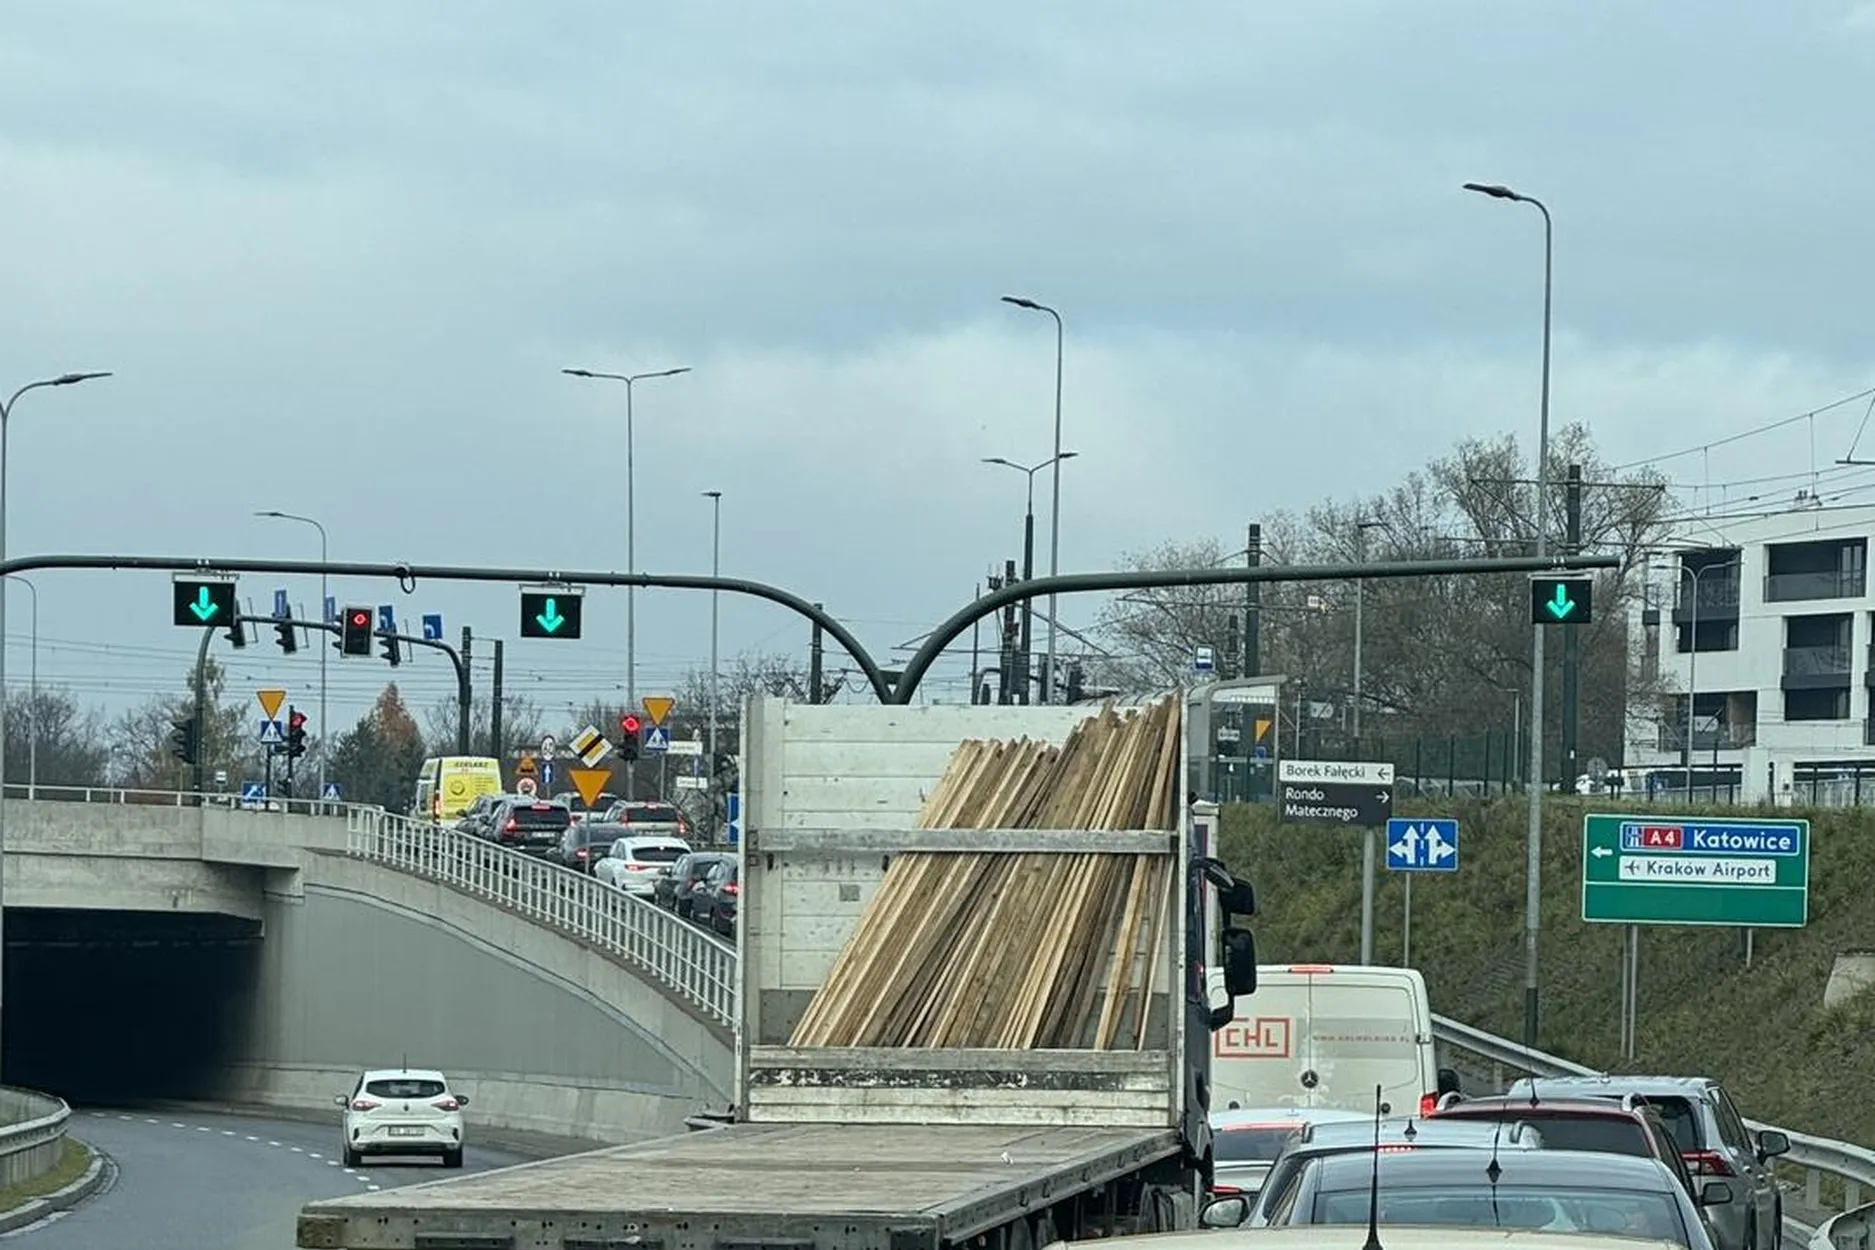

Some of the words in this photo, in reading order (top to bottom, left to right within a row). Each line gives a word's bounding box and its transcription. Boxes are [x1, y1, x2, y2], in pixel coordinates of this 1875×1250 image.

[1286, 764, 1321, 777] Borek
[1324, 765, 1366, 779] Fałęcki
[1285, 787, 1325, 800] Rondo
[1285, 804, 1359, 821] Matecznego
[1650, 830, 1676, 845] A4
[1693, 829, 1792, 850] Katowice
[1646, 859, 1707, 876] Kraków
[1712, 862, 1771, 881] Airport
[1226, 1027, 1279, 1048] CHL
